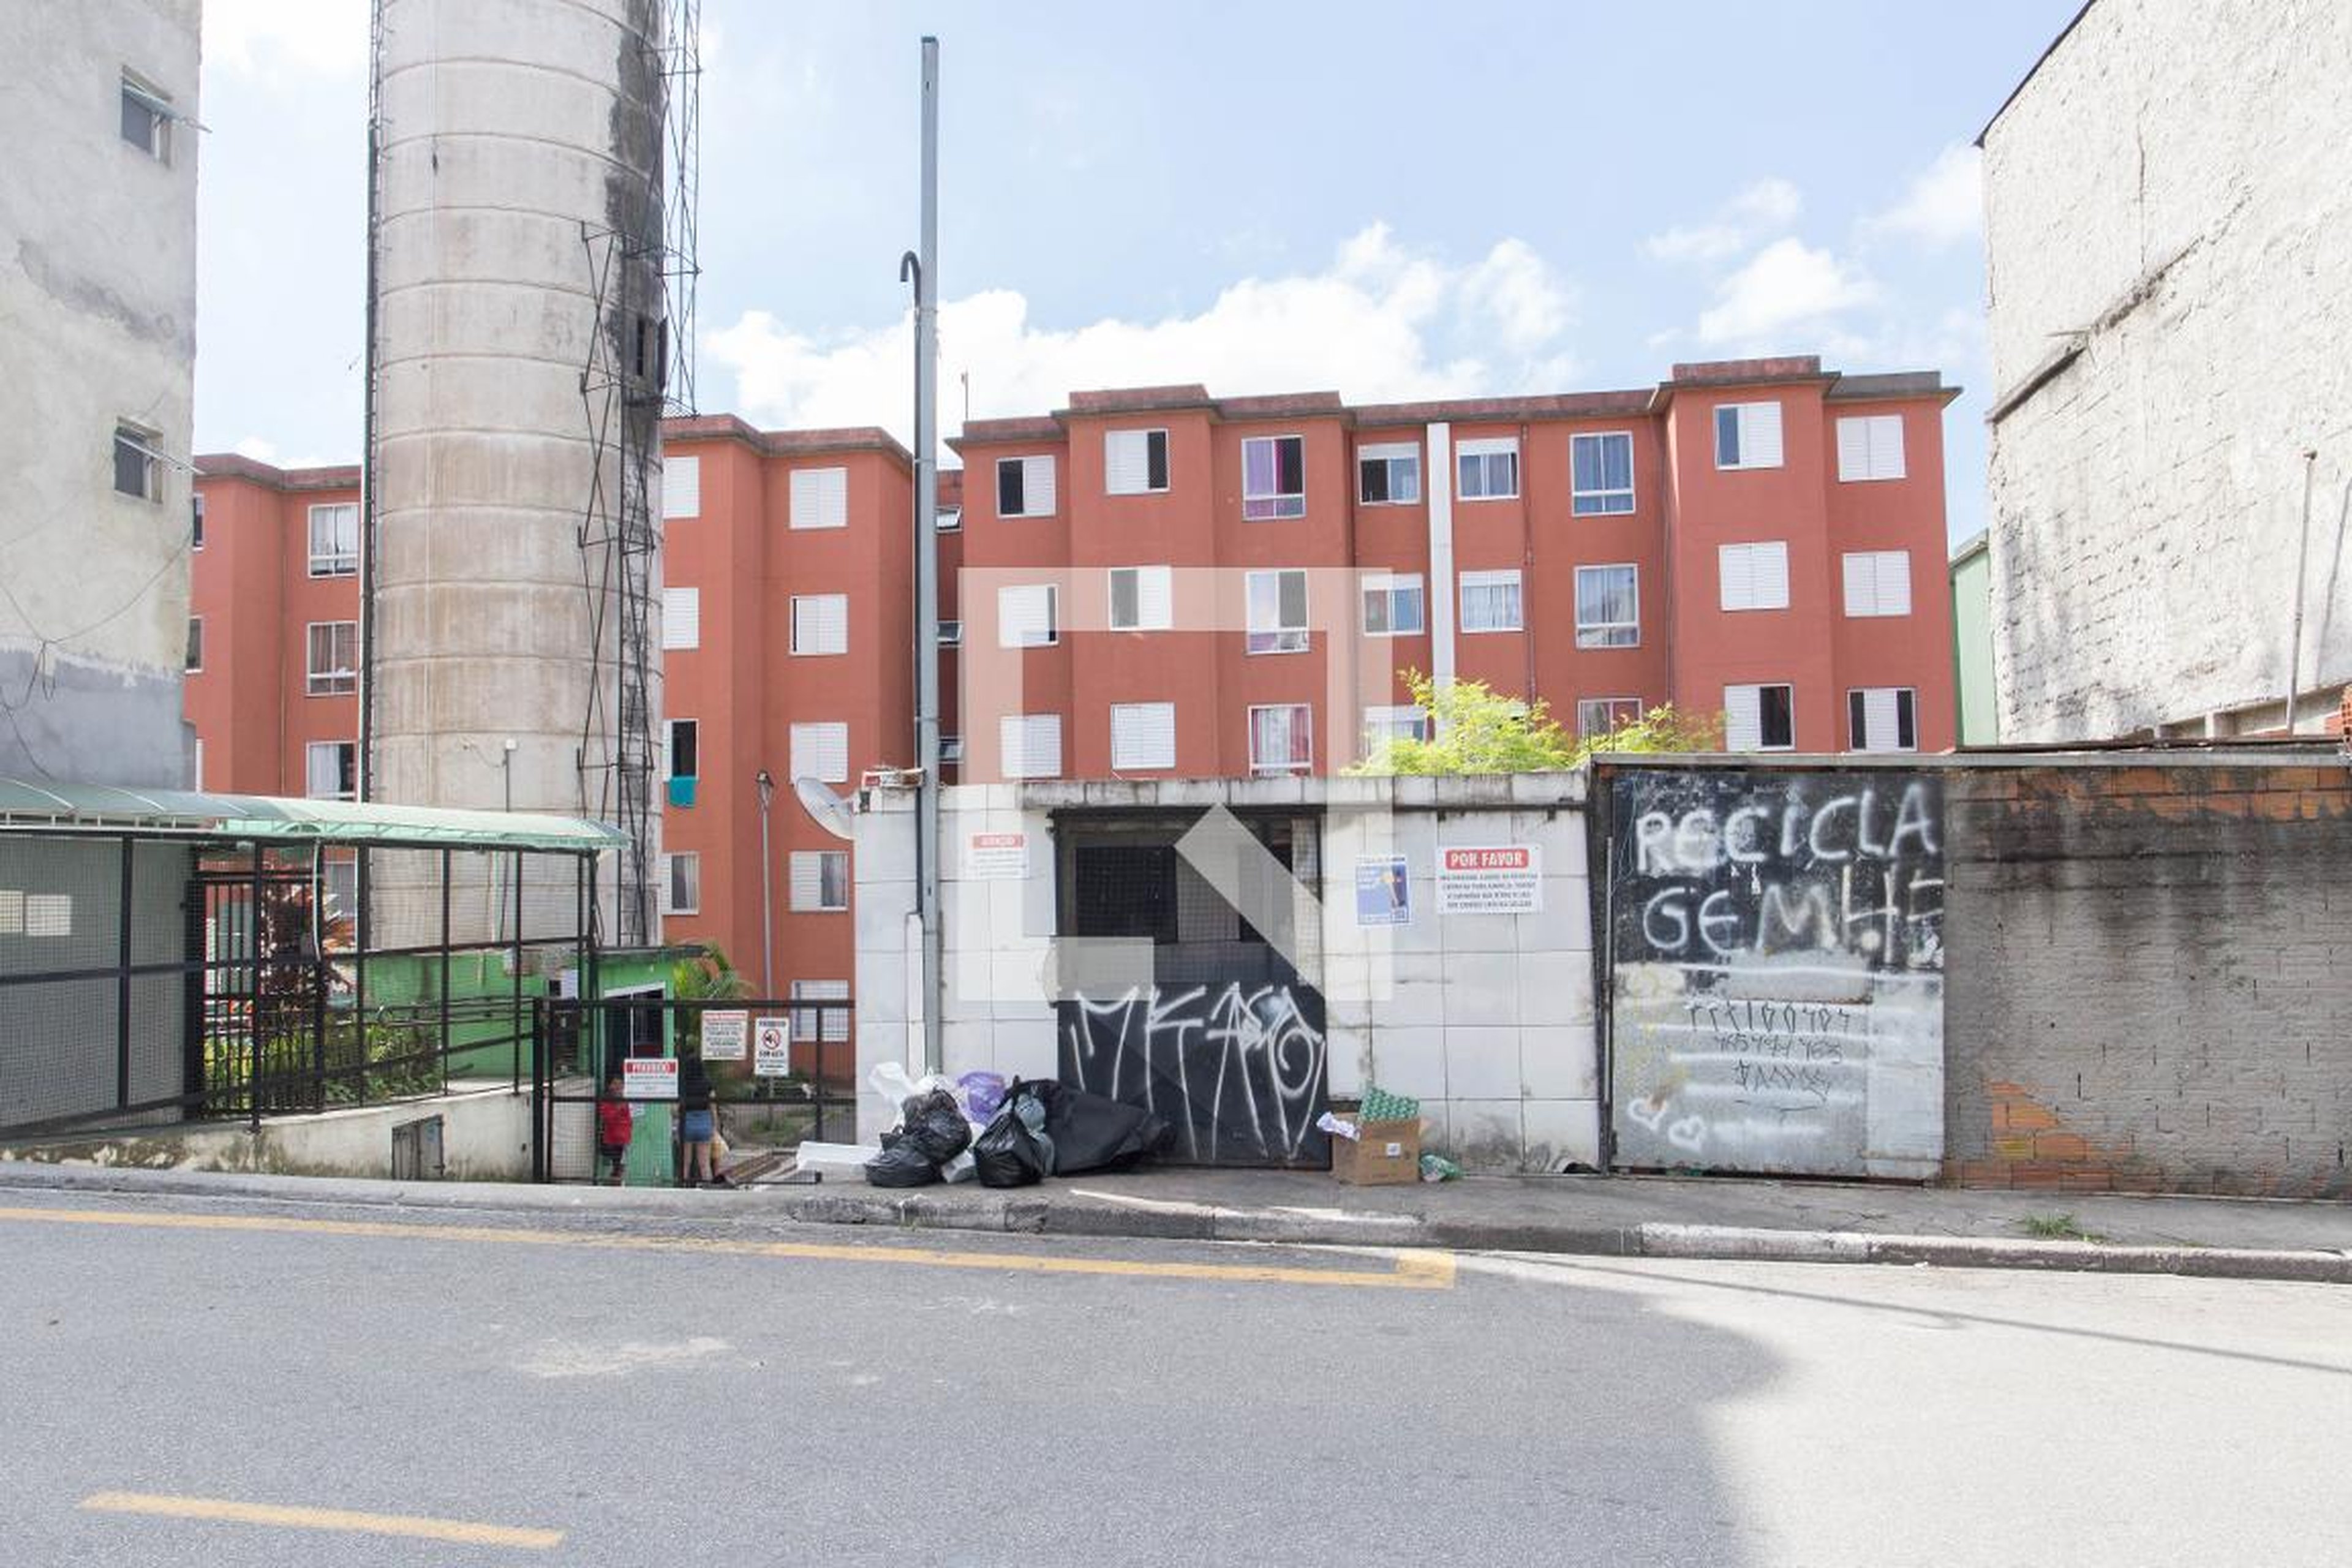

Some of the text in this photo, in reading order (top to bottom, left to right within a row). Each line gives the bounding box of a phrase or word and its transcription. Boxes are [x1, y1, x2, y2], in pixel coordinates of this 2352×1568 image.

[1637, 784, 1938, 873] RECICLA
[1451, 852, 1523, 867] POR FAVOR
